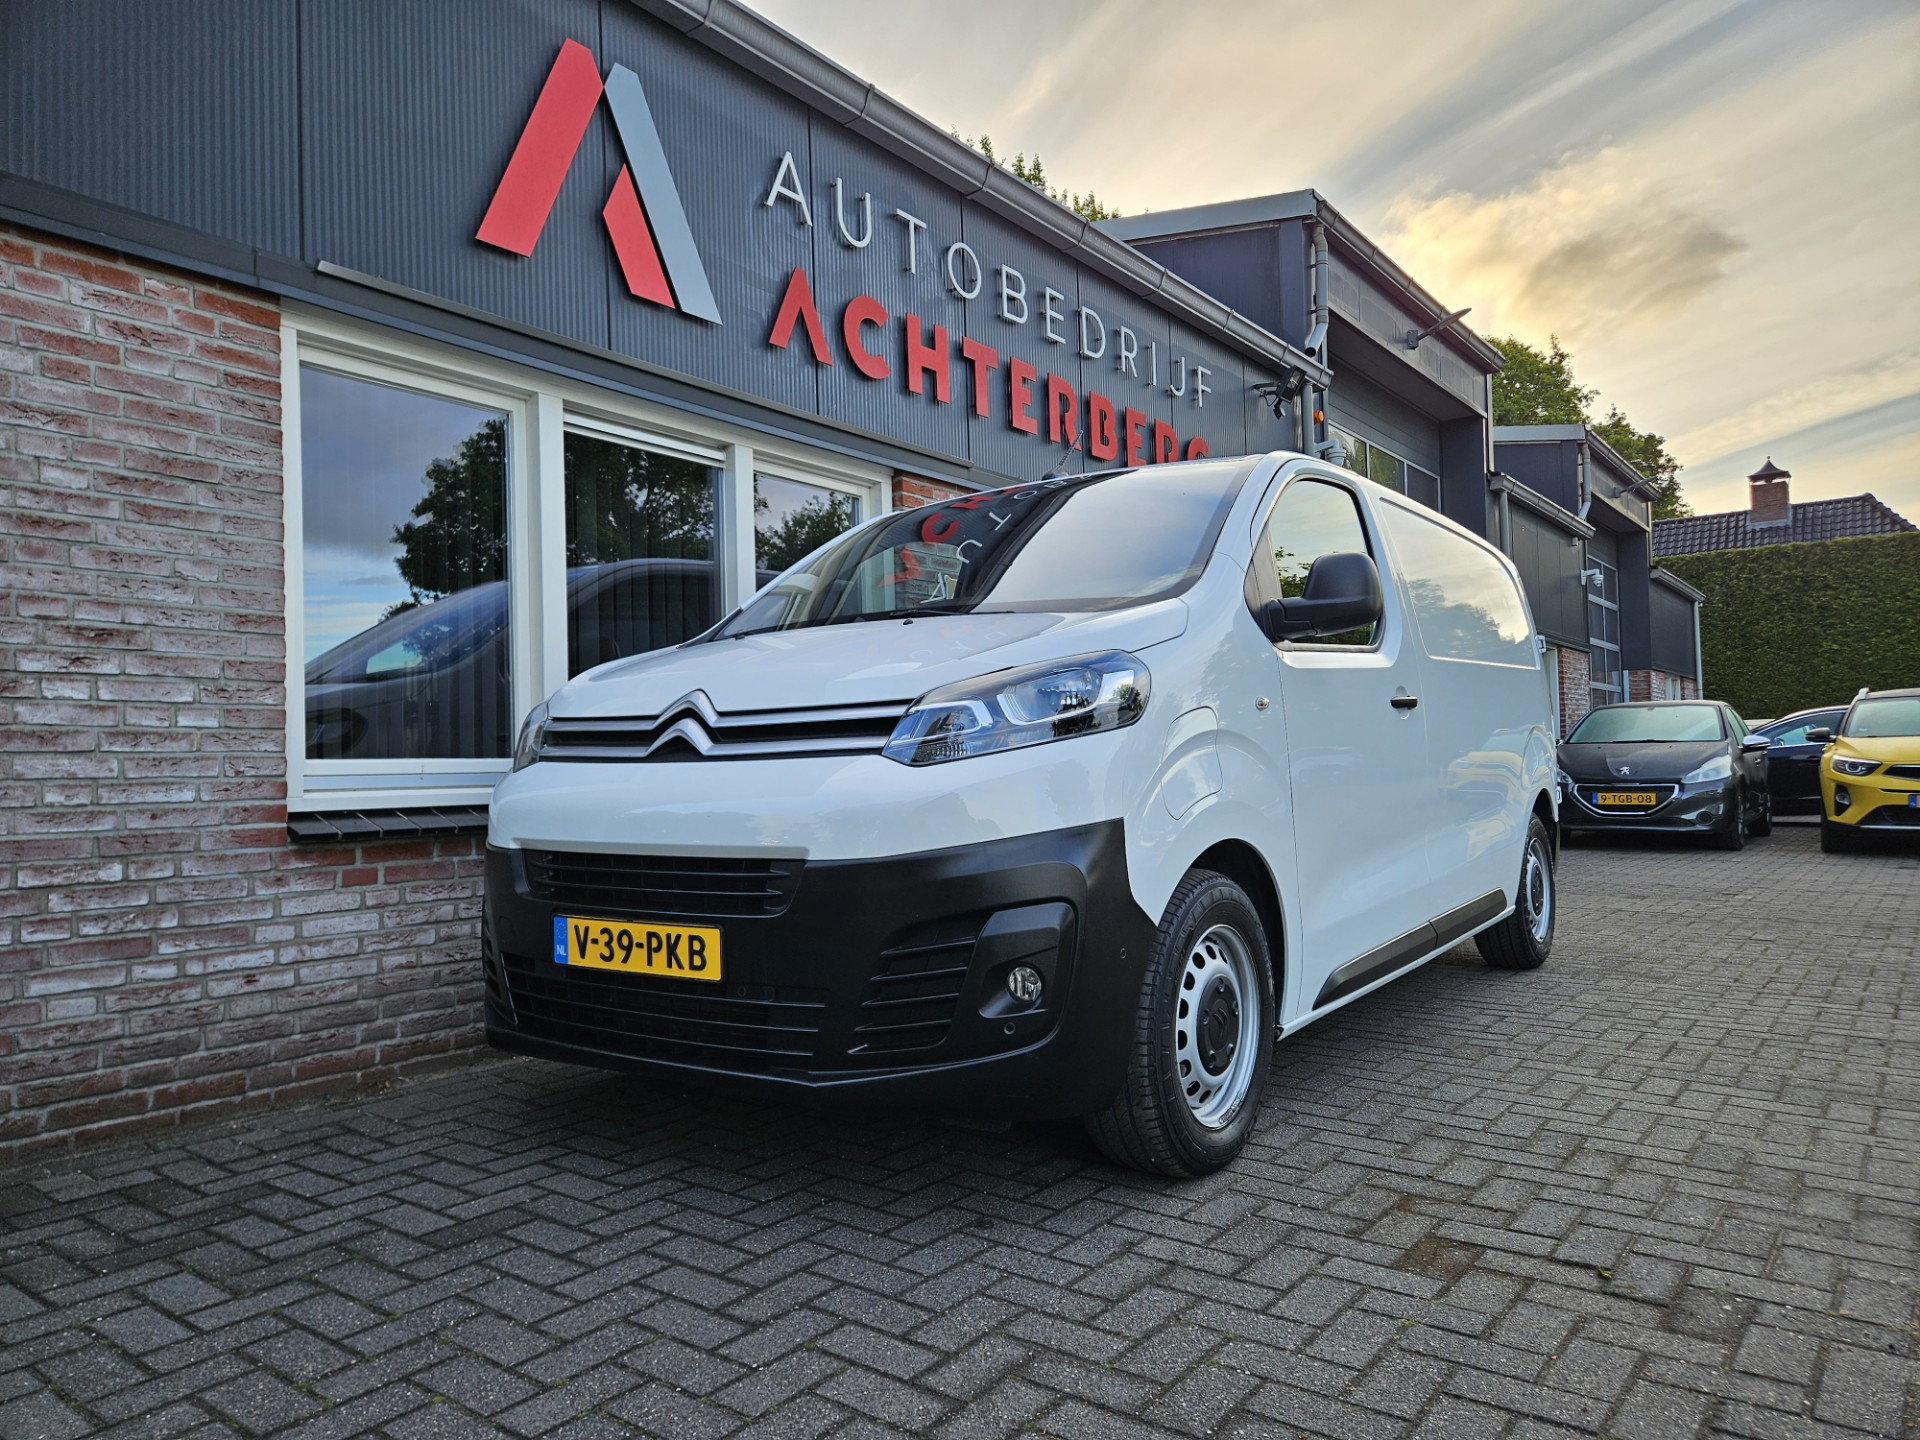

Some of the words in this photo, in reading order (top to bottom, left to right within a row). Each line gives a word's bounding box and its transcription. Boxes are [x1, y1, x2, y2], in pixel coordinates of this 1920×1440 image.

[766, 151, 1212, 407] AUTOBEDRIJF
[1600, 794, 1653, 804] 9-TGB-08
[556, 944, 567, 956] NL
[574, 924, 707, 971] V-39-PKB
